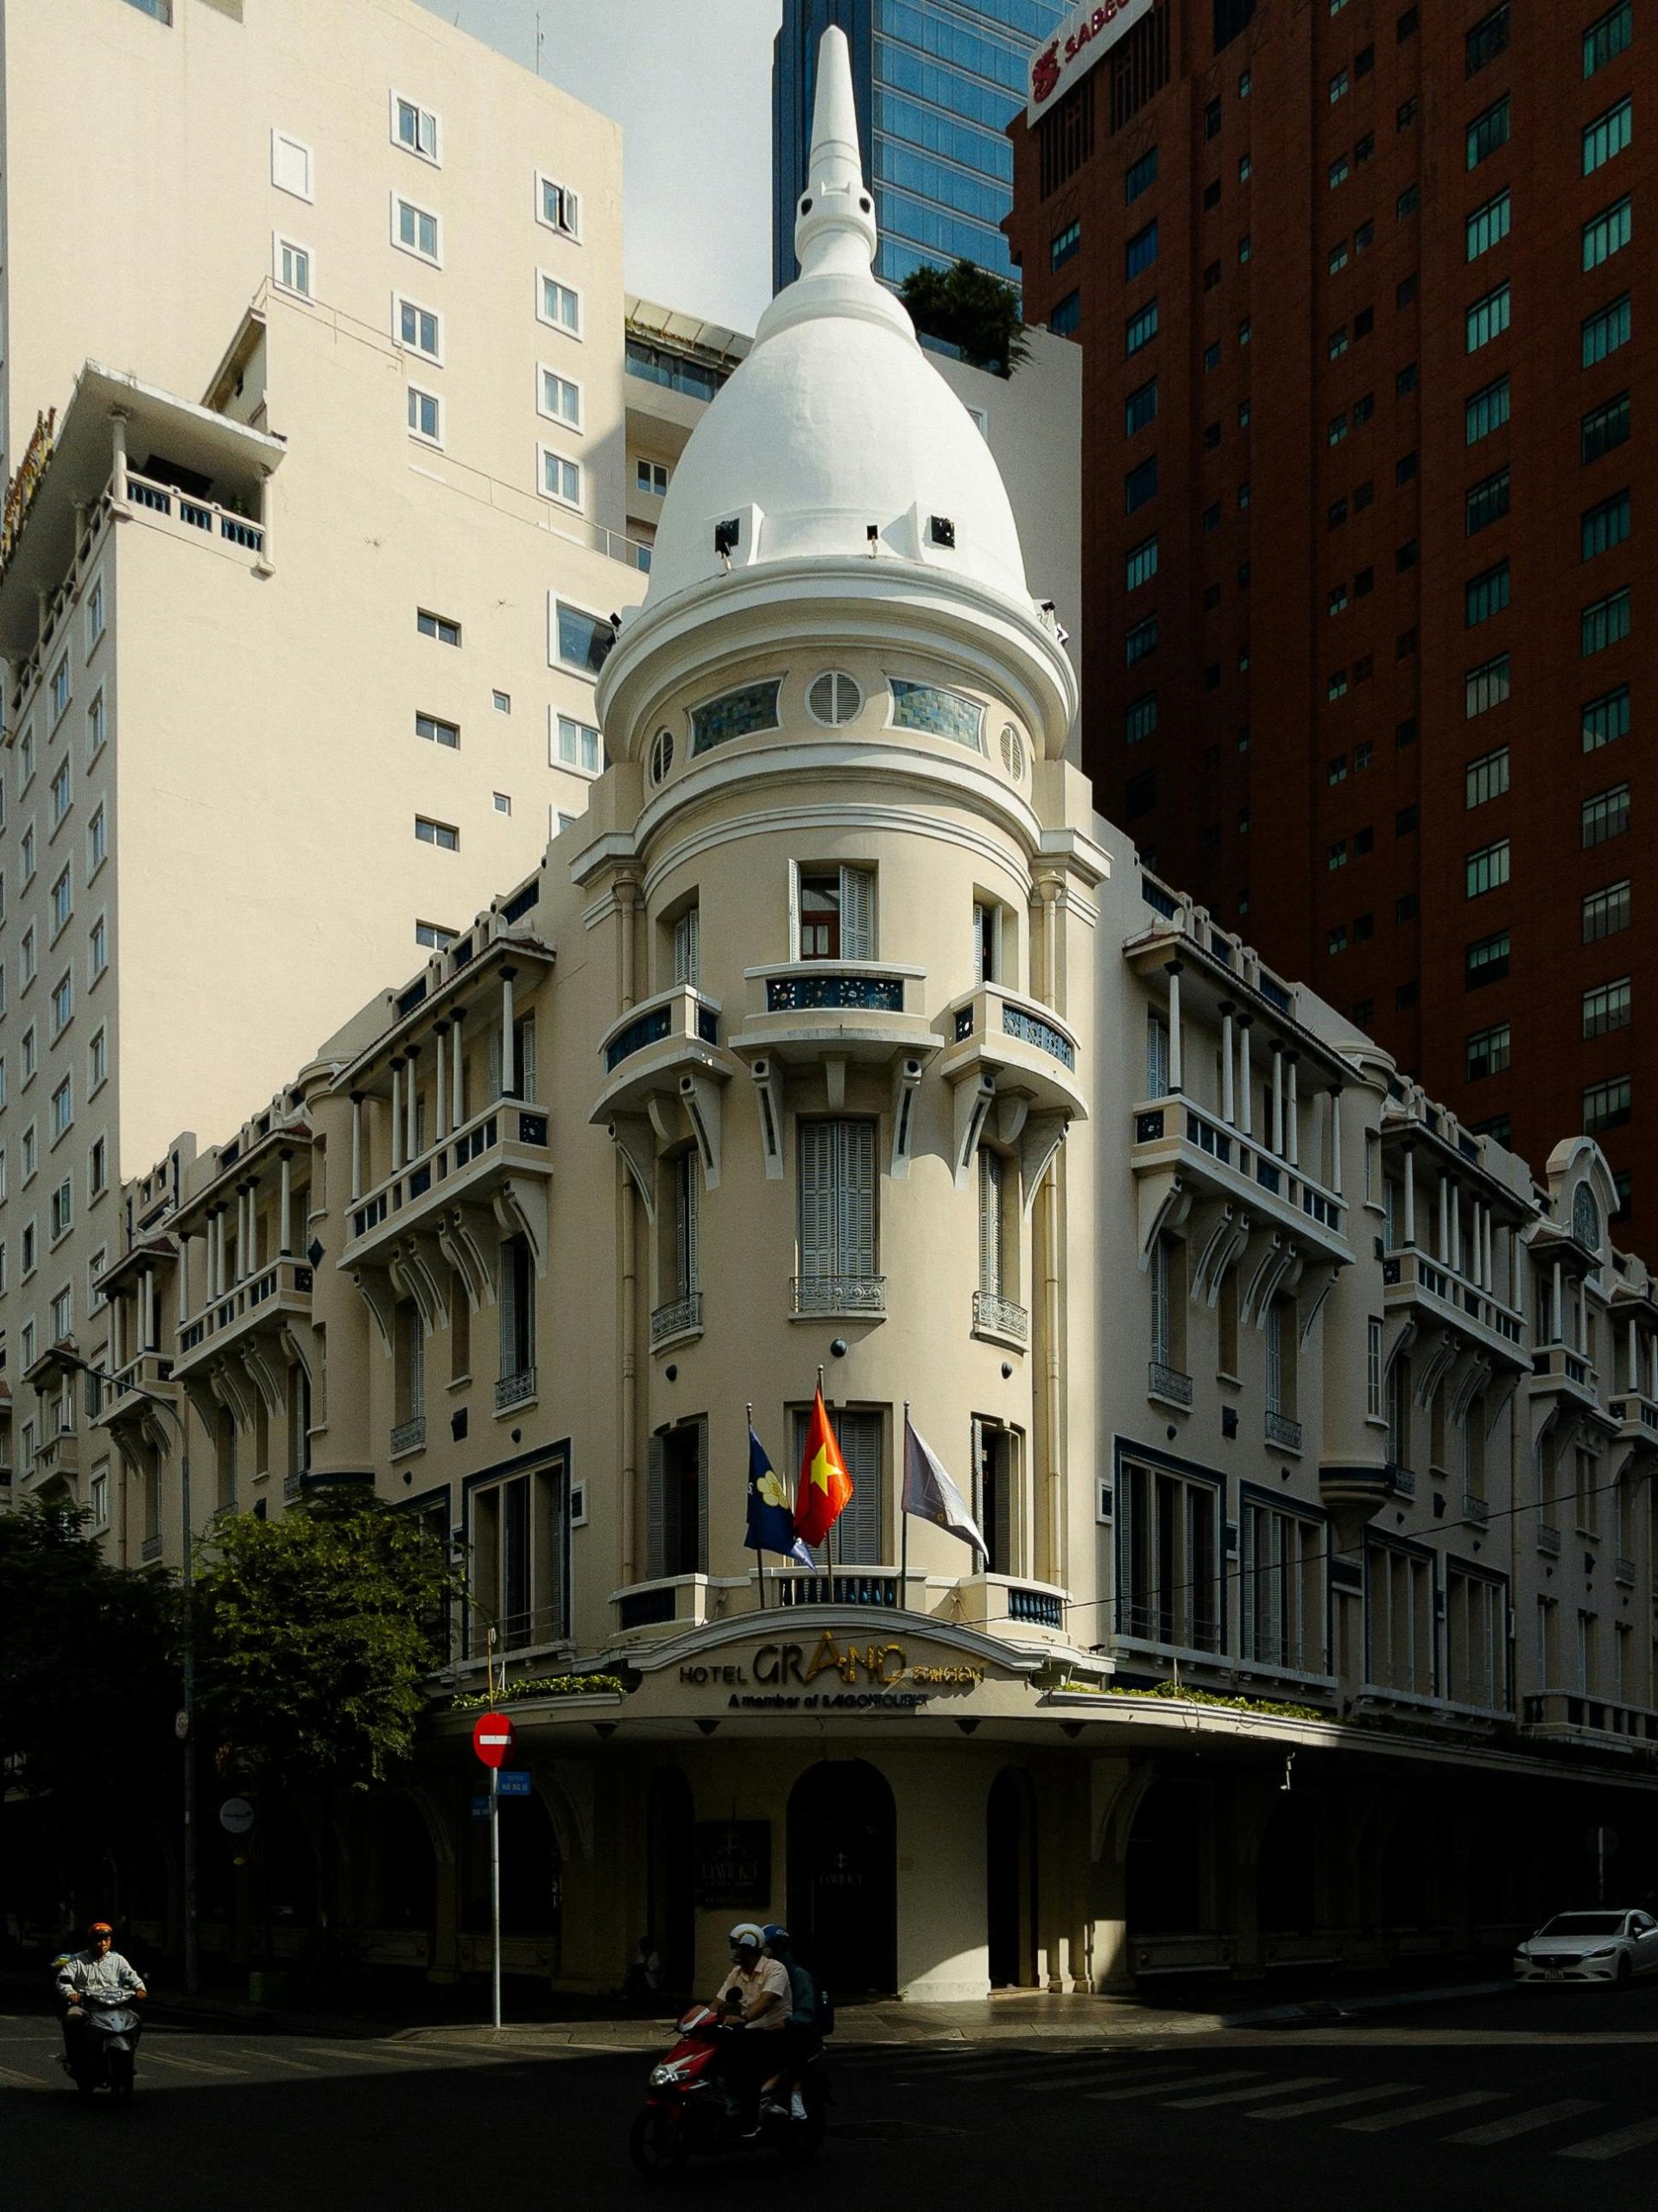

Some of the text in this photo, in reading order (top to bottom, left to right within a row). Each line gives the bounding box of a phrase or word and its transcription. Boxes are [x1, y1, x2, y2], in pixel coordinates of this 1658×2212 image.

[680, 1665, 747, 1683] HOTEL
[753, 1630, 907, 1685] GRAND
[729, 1694, 739, 1708] A
[742, 1694, 801, 1708] member
[804, 1694, 819, 1708] of
